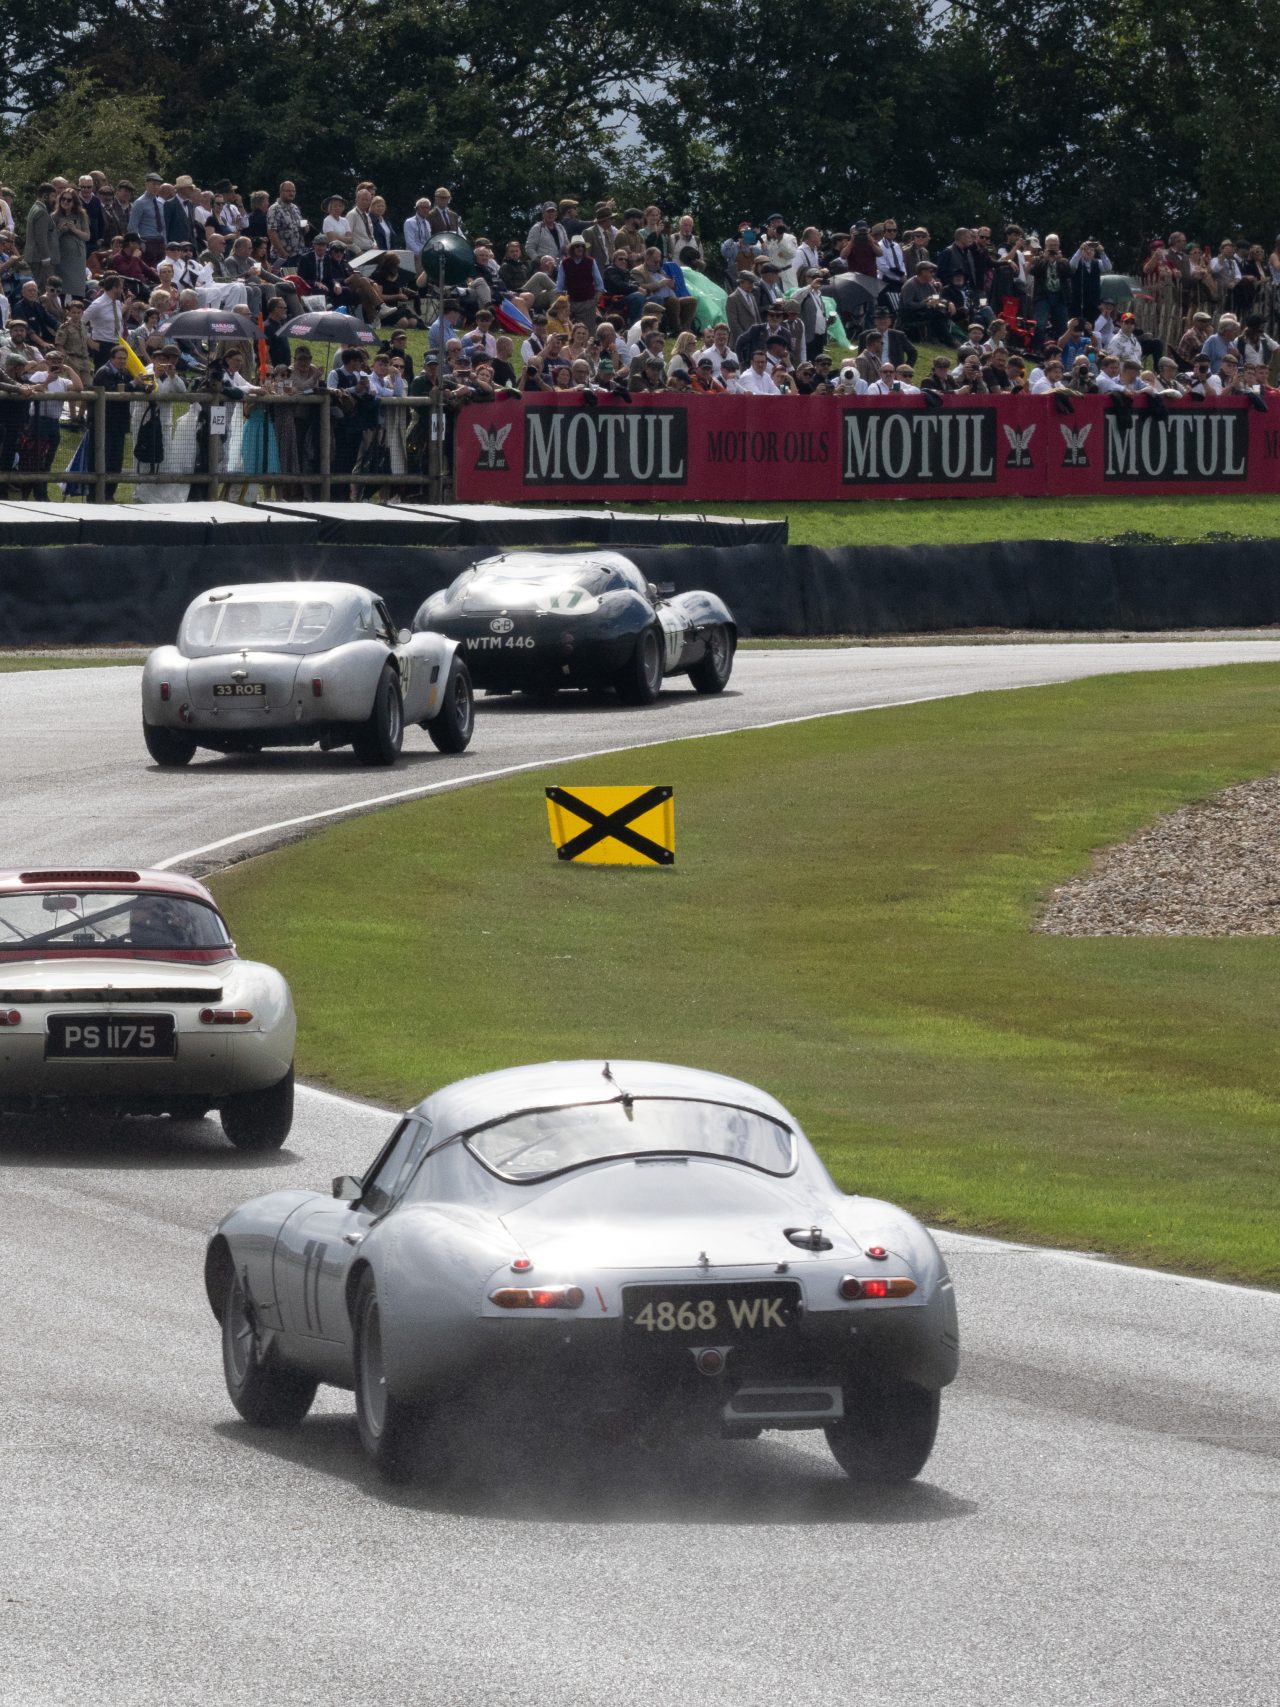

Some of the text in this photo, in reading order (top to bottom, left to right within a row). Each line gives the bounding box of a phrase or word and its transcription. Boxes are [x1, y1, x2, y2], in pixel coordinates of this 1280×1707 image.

[525, 413, 683, 480] MOTUL
[706, 430, 830, 463] MOTOR OILS
[844, 414, 993, 479] MOTUL
[1105, 414, 1245, 476] MOTUL
[466, 636, 535, 650] WTM 446
[217, 685, 262, 695] 33 ROE
[65, 1026, 155, 1048] PS 1175
[634, 1298, 786, 1332] 4868 WK
